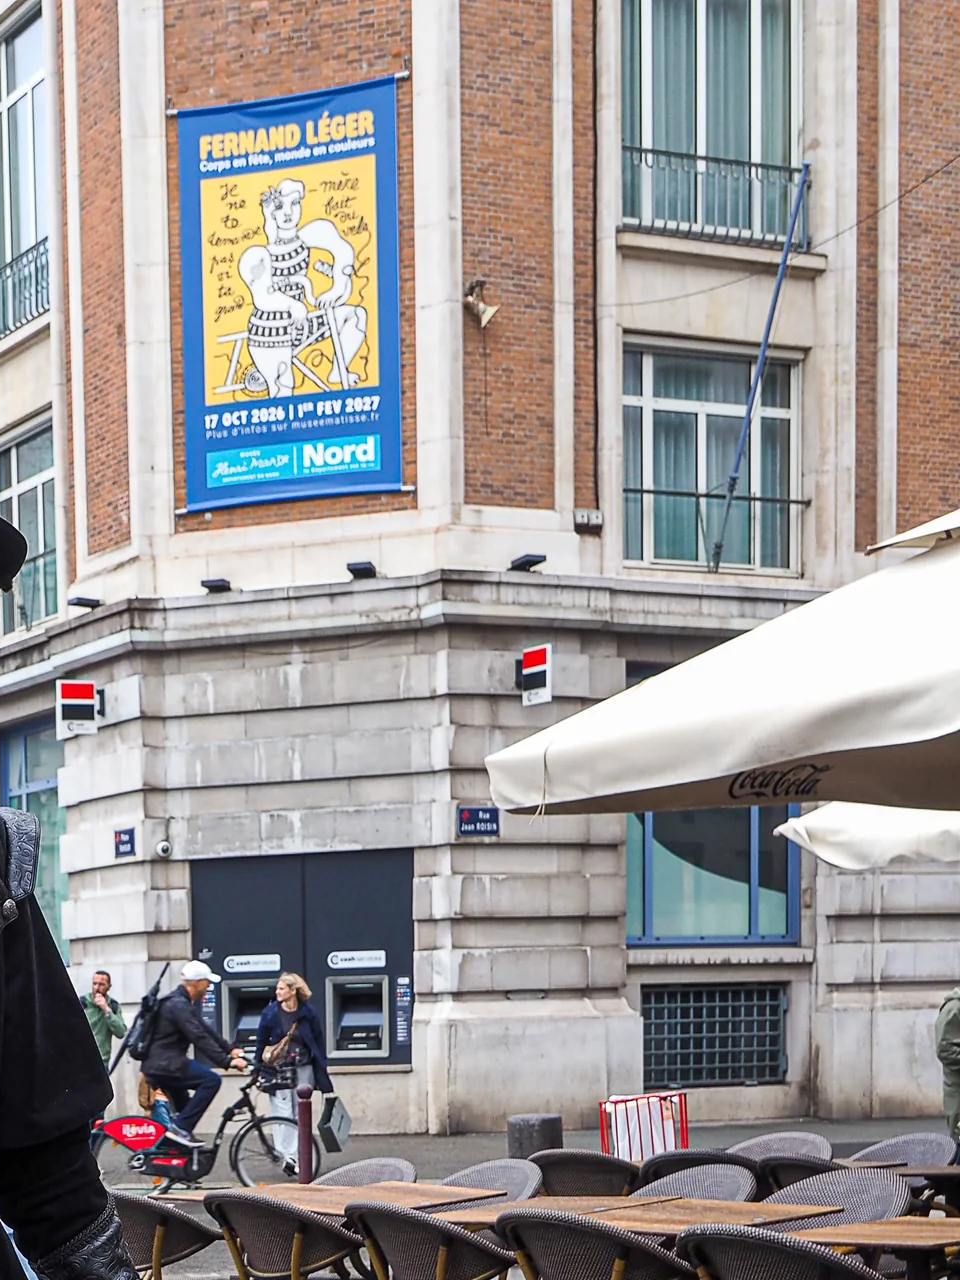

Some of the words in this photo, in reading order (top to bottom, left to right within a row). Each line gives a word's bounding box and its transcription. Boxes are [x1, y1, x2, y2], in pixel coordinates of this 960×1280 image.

[199, 123, 301, 160] FERNAND
[306, 109, 374, 145] LÉGER
[199, 159, 231, 173] Corps
[232, 157, 247, 168] en
[247, 153, 273, 166] fête,
[274, 146, 311, 162] monde
[312, 145, 327, 157] en
[327, 136, 375, 154] couleurs
[204, 413, 219, 430] 17
[221, 409, 249, 427] OCT
[250, 405, 286, 424] 2026
[316, 398, 342, 416] FEV
[345, 395, 381, 413] 2027
[205, 429, 229, 440] Plus
[271, 422, 288, 432] sur
[302, 435, 375, 468] Nord
[478, 810, 490, 819] Rue
